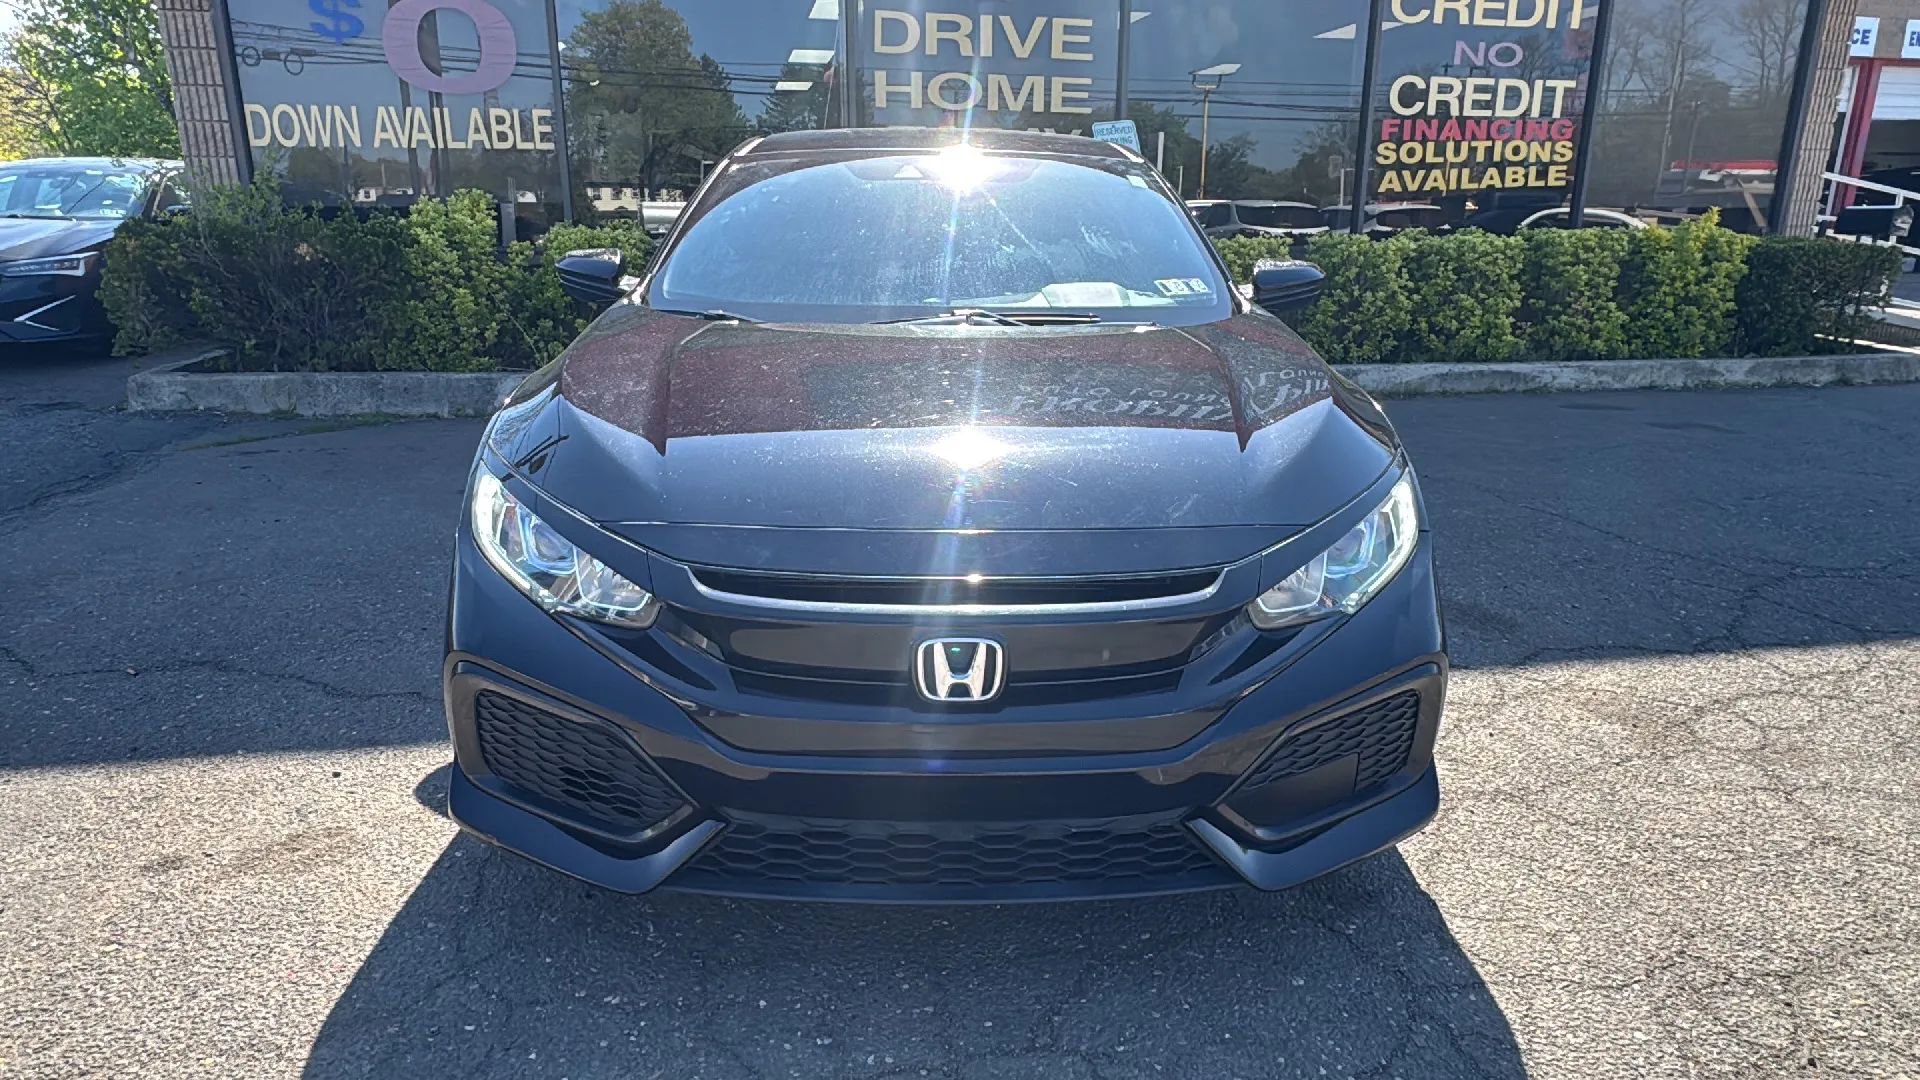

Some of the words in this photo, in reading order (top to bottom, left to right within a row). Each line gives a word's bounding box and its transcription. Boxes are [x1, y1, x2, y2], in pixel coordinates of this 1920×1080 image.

[1391, 0, 1582, 29] CREDIT
[874, 10, 1094, 61] DRIVE
[1453, 40, 1524, 67] NO
[874, 70, 1093, 114] HOME
[1389, 74, 1577, 118] CREDIT
[244, 103, 362, 148] DOWN
[373, 106, 555, 150] AVAILABLE
[1381, 117, 1576, 141] FINANCING
[1376, 139, 1574, 165] SOLUTIONS
[1377, 165, 1568, 193] AVAILABLE
